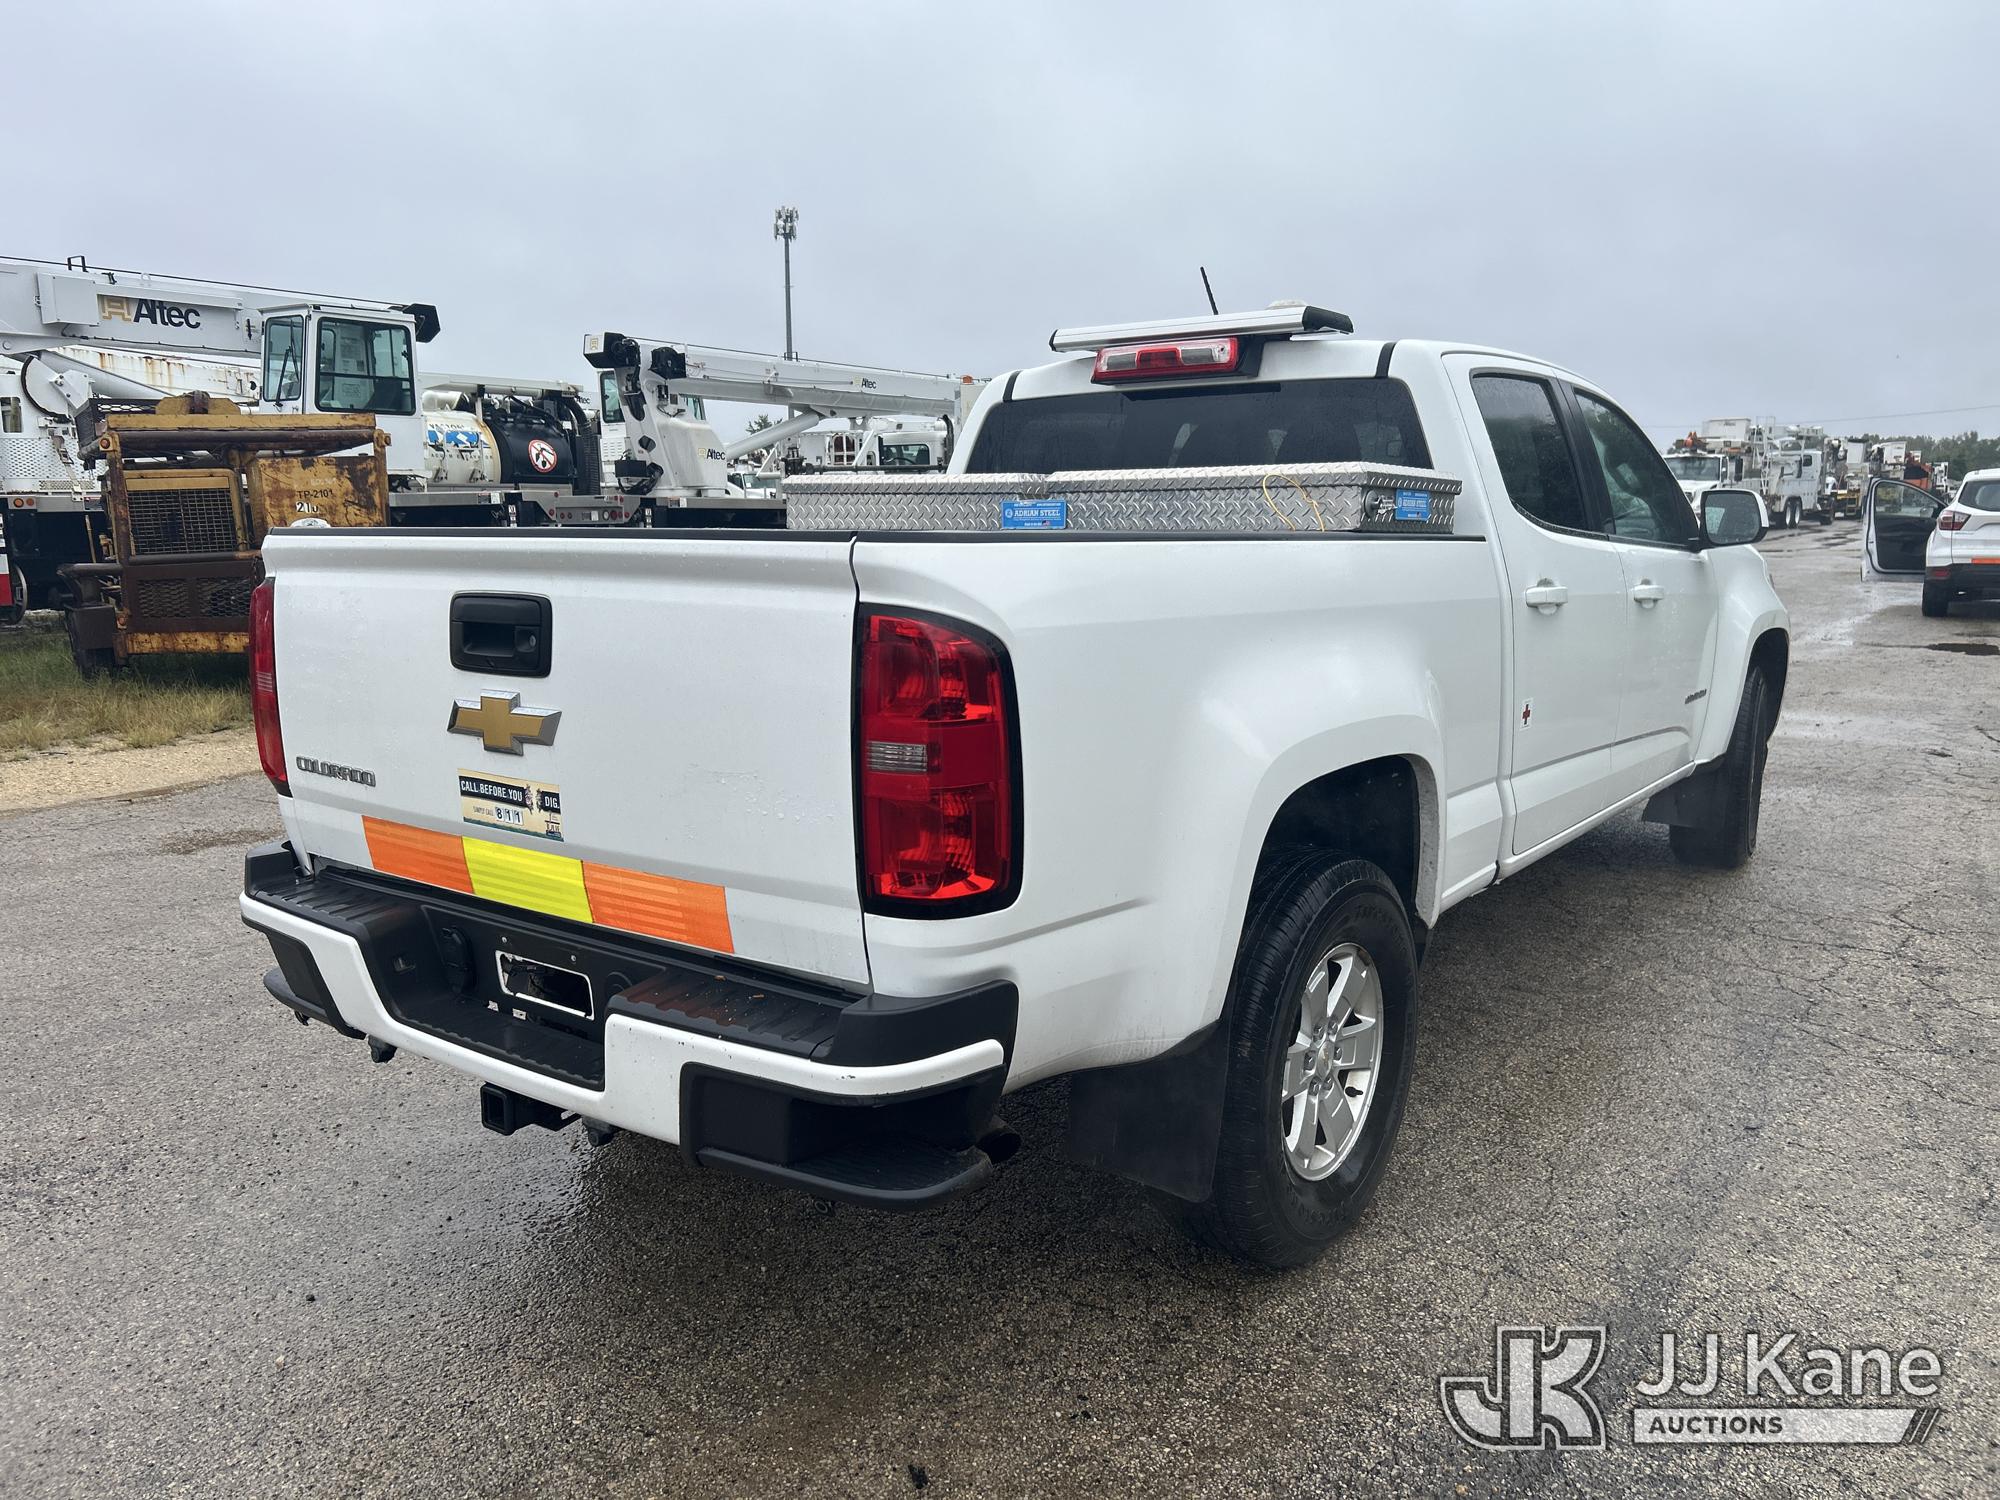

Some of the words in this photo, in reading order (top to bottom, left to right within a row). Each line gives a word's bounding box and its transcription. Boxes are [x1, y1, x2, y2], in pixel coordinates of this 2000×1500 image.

[133, 298, 201, 329] Altec
[861, 377, 877, 389] Altec
[706, 448, 726, 460] Altec
[1014, 509, 1039, 517] ADRIAN
[1040, 509, 1061, 517] STEEL
[296, 756, 376, 787] COLORADO
[461, 780, 479, 793] CALL
[480, 783, 507, 798] BEFORE
[508, 789, 523, 802] YOU
[544, 796, 560, 809] DIG.
[496, 808, 521, 823] 811
